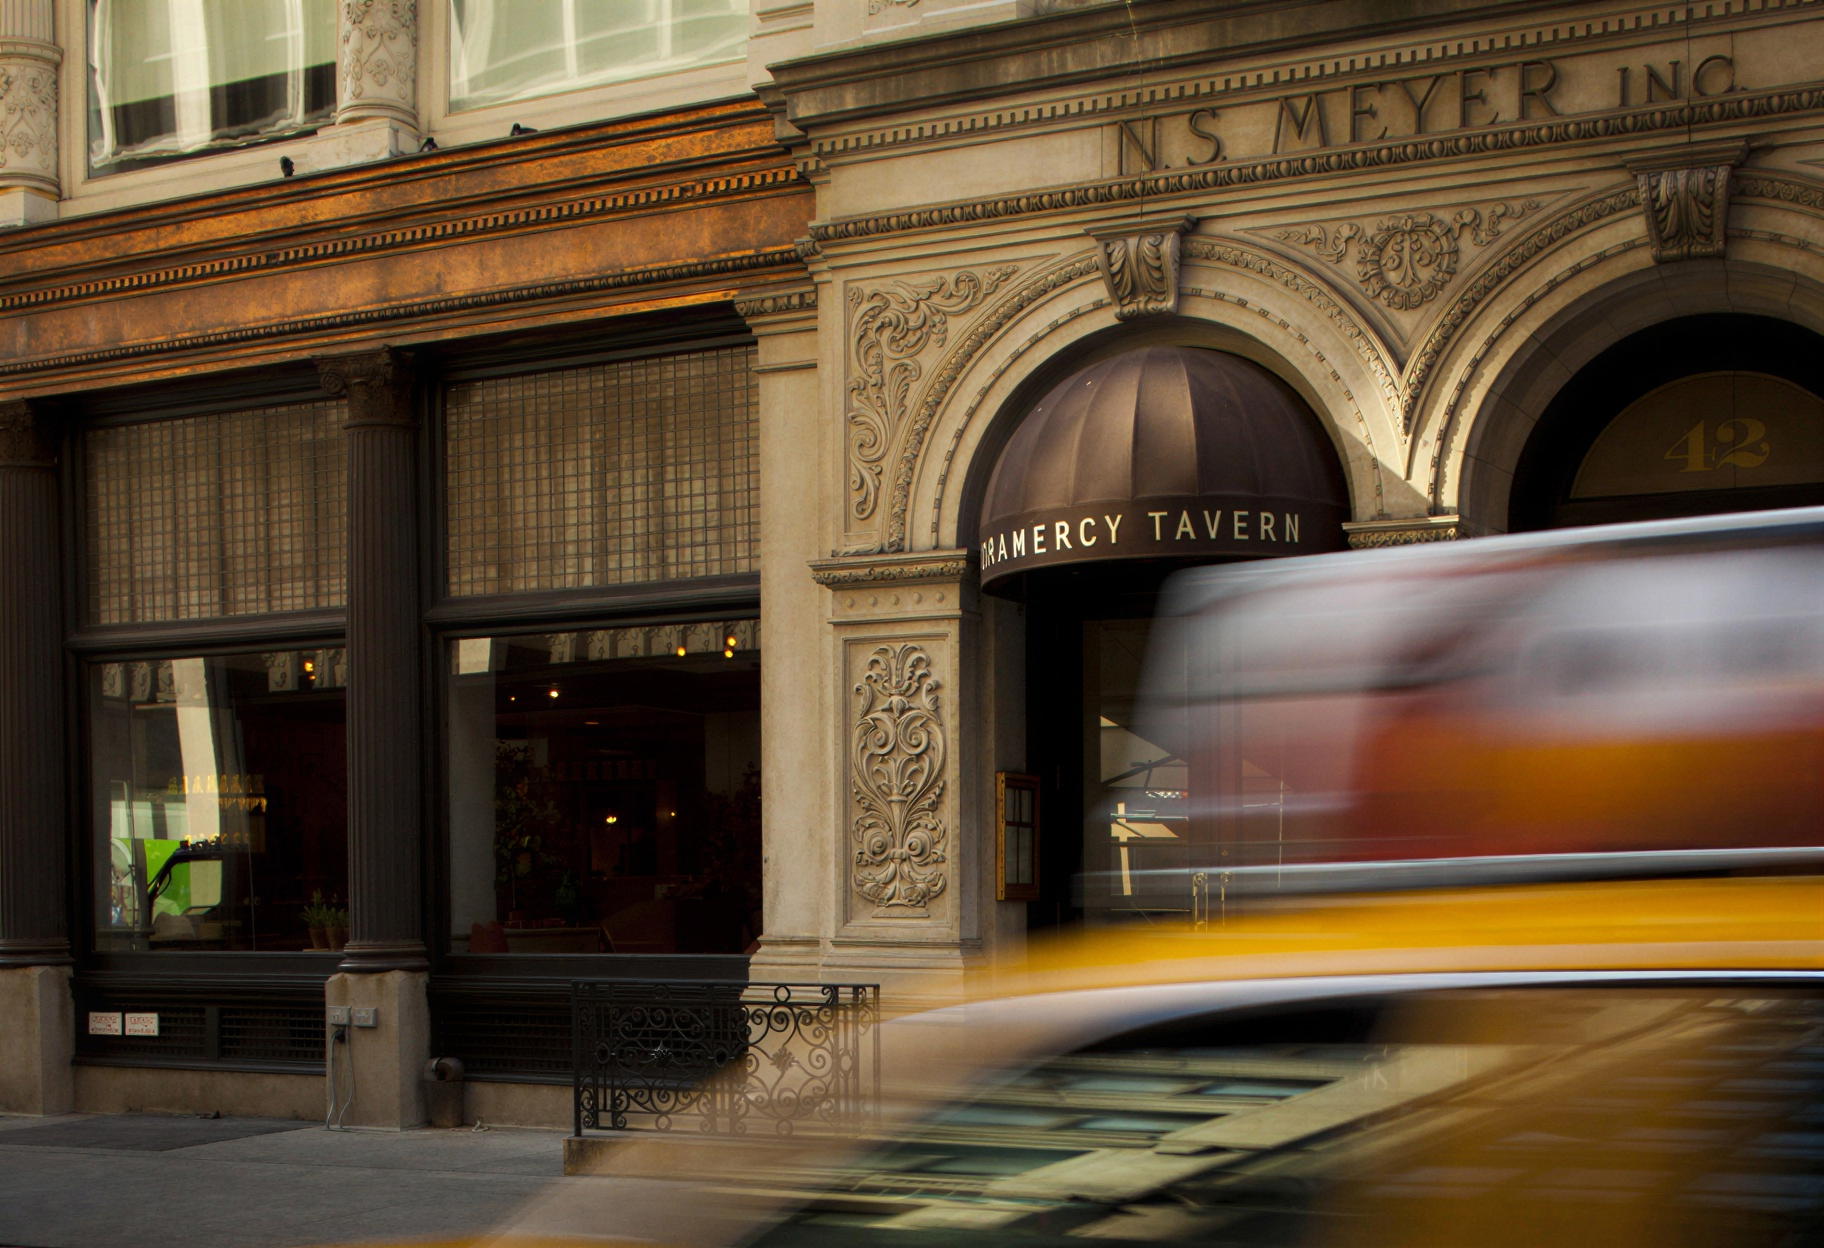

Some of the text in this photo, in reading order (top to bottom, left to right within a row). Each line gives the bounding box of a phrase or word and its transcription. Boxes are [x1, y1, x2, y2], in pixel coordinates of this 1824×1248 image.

[1271, 58, 1559, 155] MEYER
[1663, 418, 1770, 473] 42
[1148, 510, 1299, 543] TAVERN
